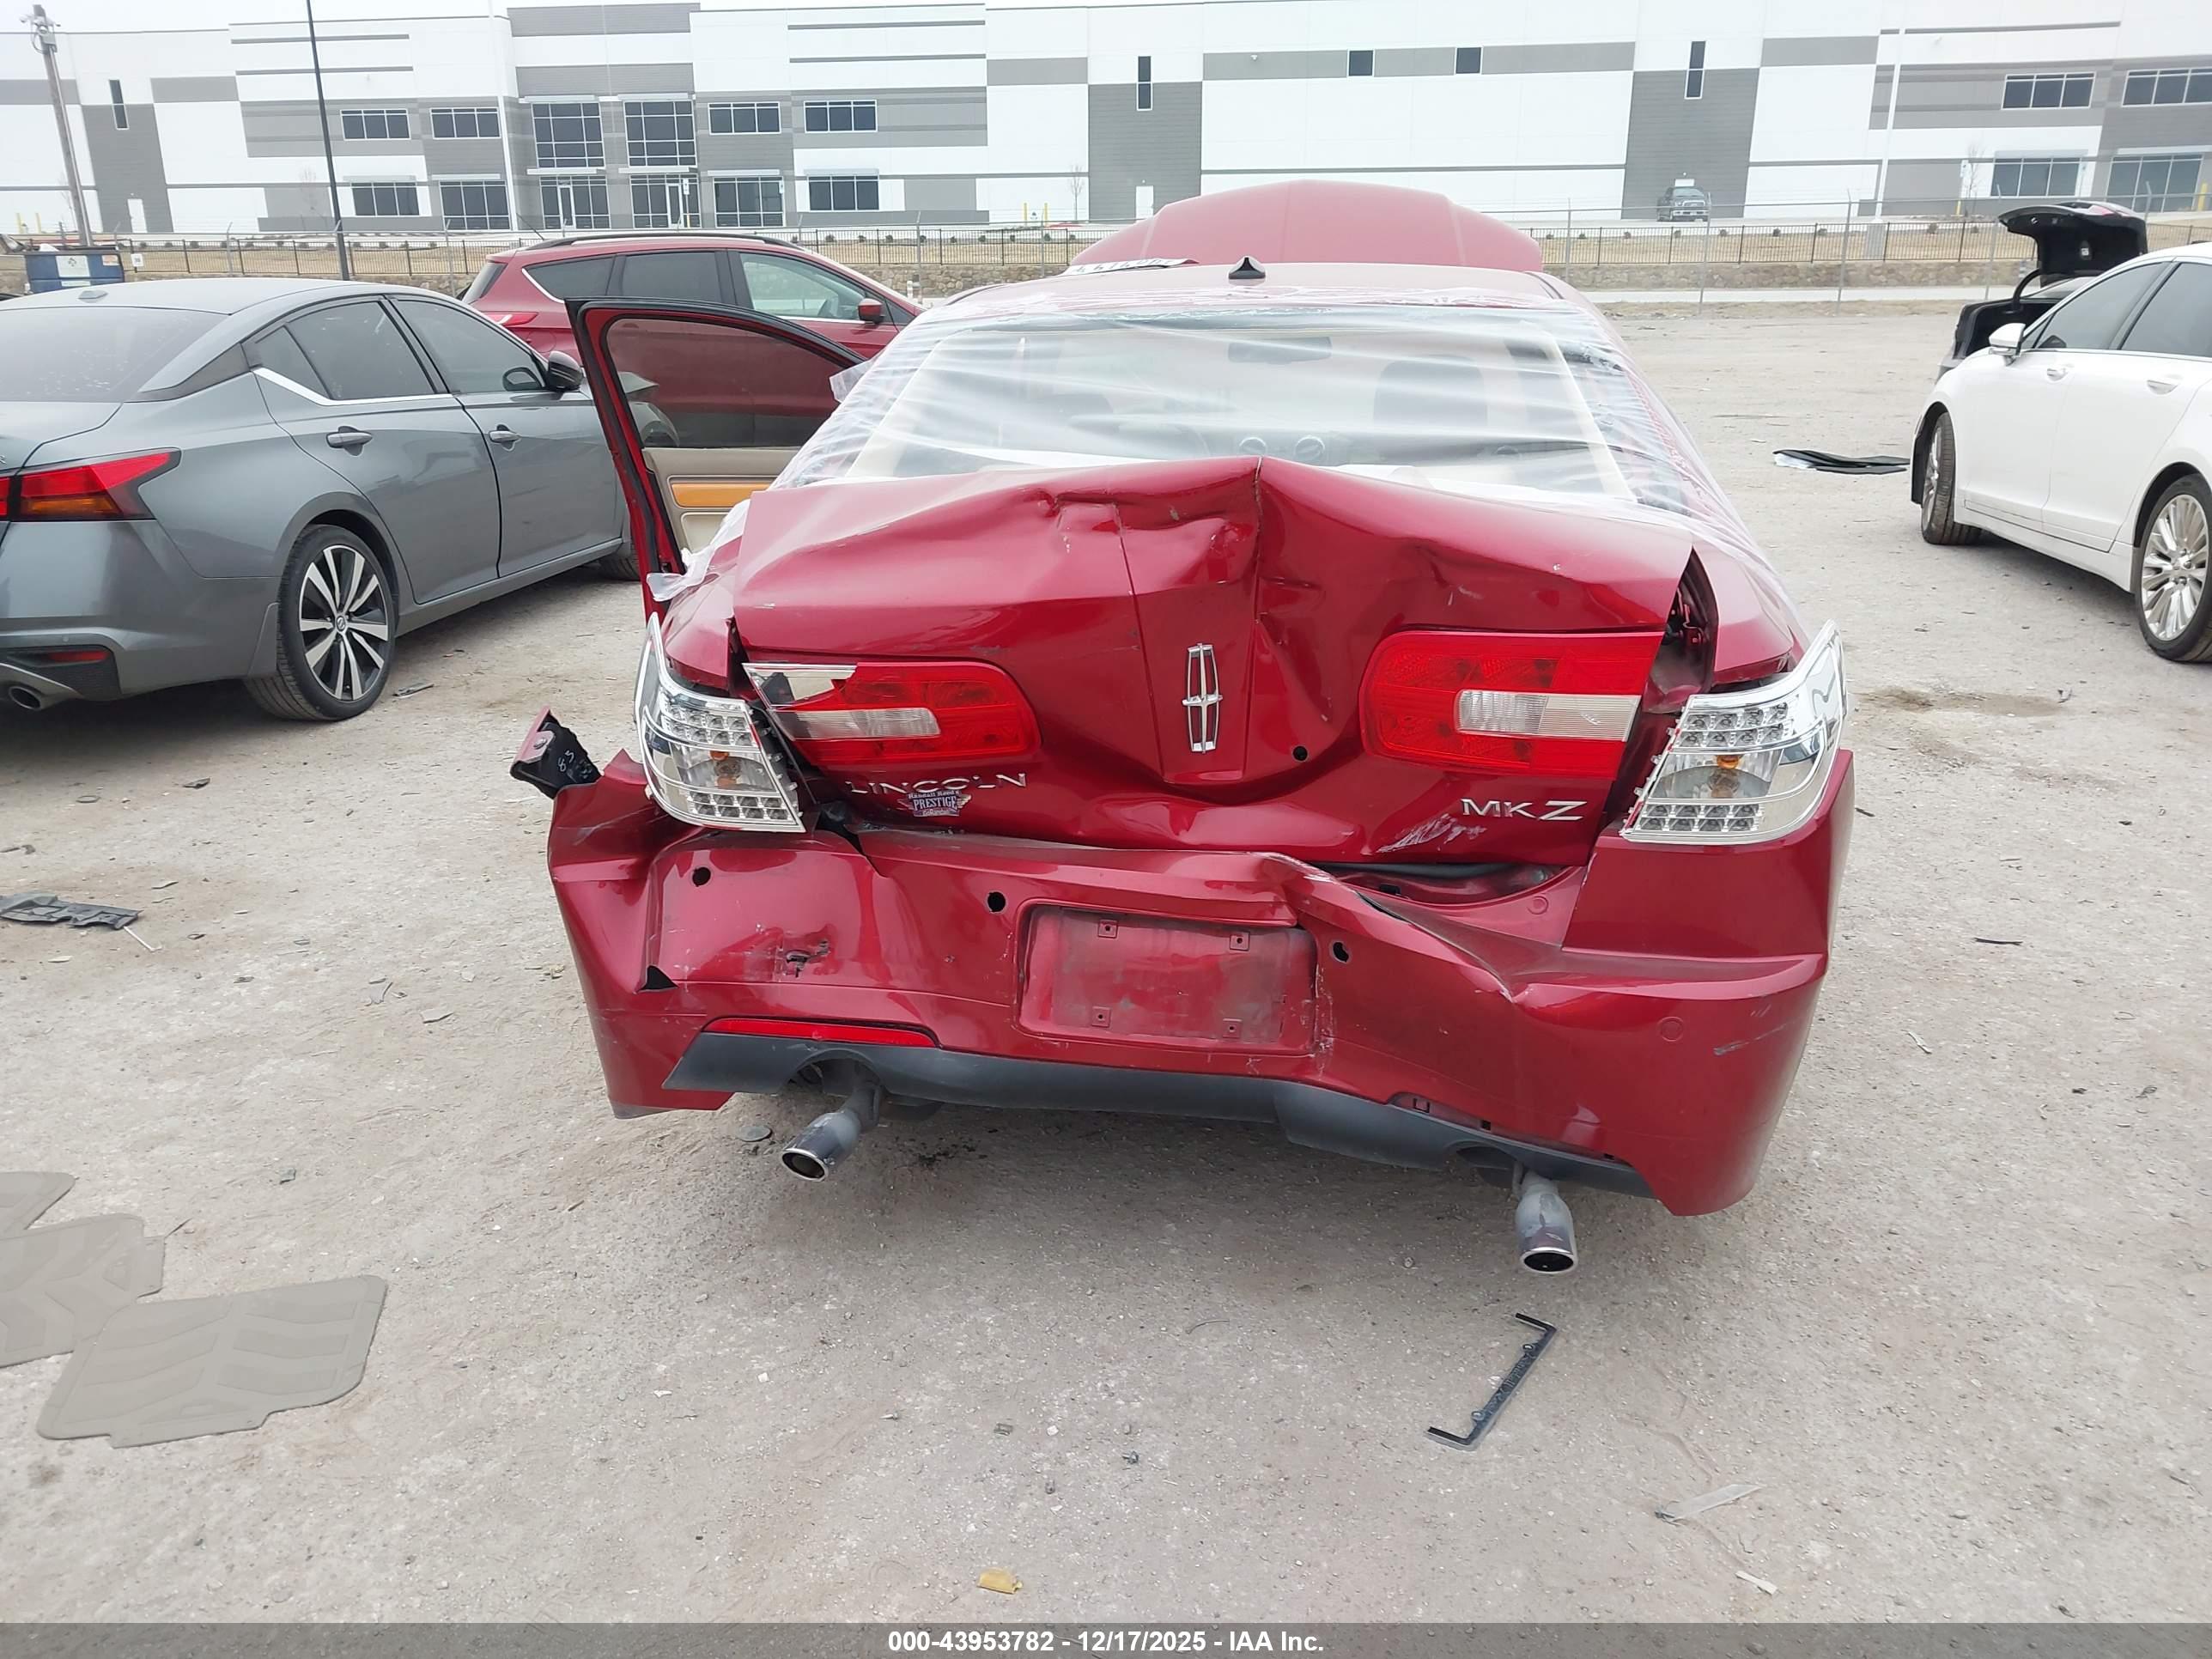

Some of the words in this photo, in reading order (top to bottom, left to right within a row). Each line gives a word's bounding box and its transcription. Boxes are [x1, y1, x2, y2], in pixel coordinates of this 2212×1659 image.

[845, 772, 1027, 794] LINCOLN
[913, 795, 958, 811] PRESTIGE
[1460, 799, 1588, 821] MKZ
